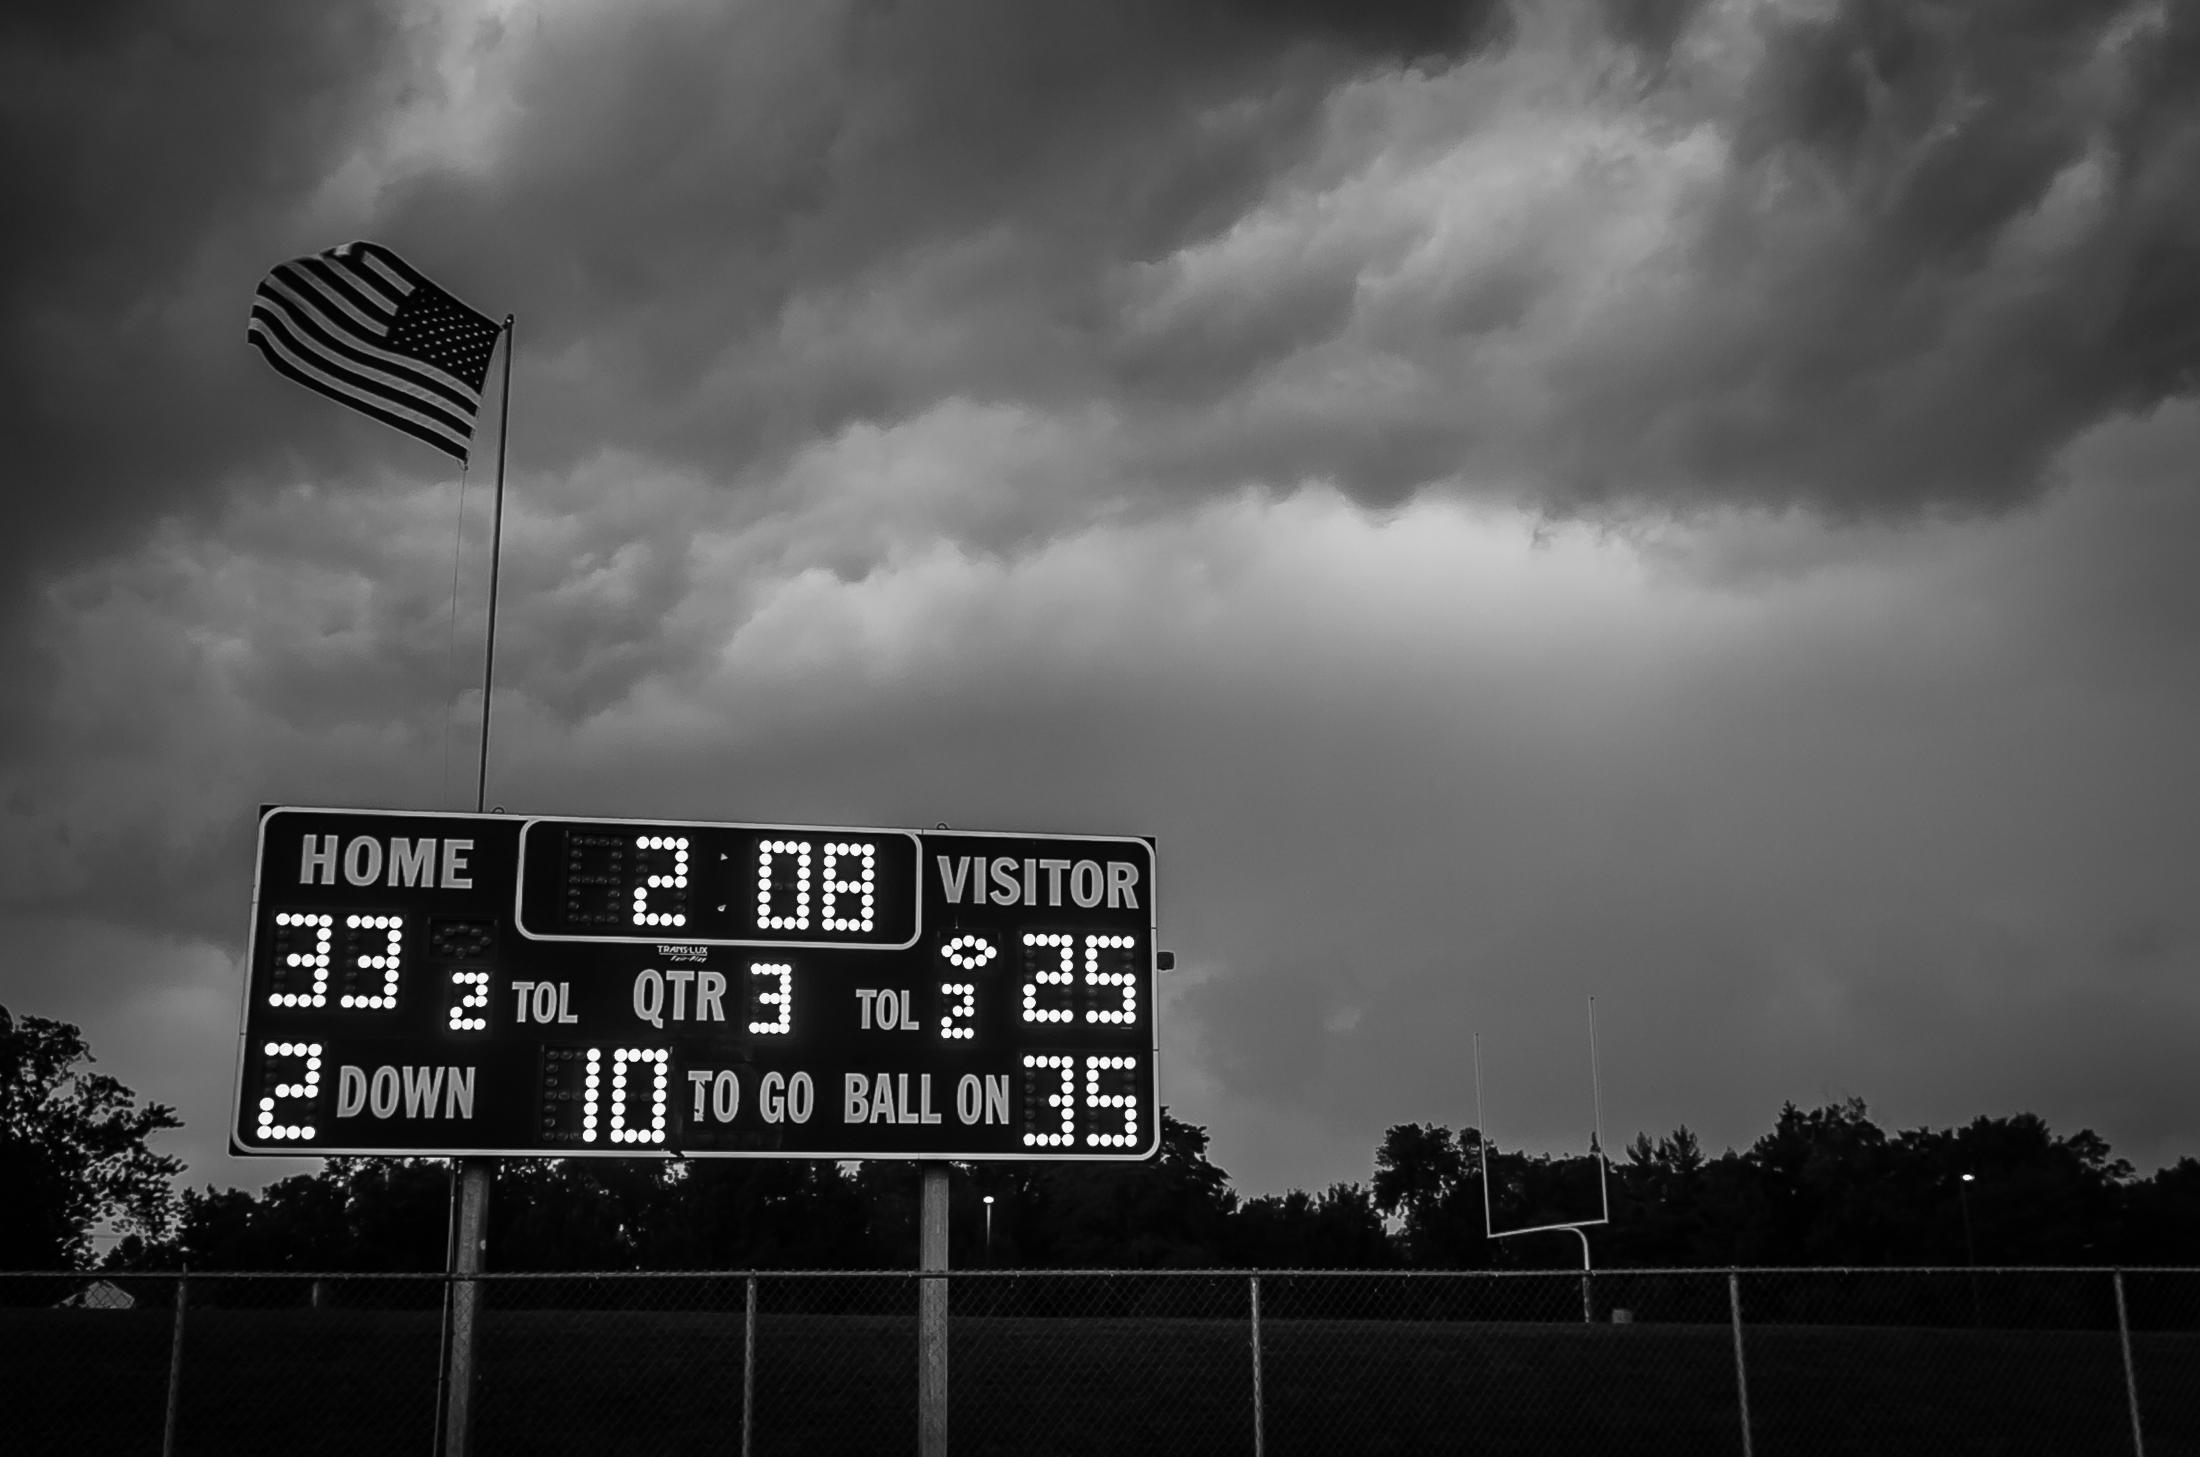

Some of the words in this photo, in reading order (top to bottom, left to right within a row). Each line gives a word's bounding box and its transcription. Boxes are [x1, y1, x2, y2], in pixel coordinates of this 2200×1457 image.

[300, 835, 473, 888] HOME
[937, 856, 1138, 908] VISITOR
[269, 914, 402, 1008] 33
[634, 969, 726, 1028] QTR
[749, 963, 791, 1034] 3
[1023, 934, 1136, 1024] 25
[450, 973, 488, 1030] 2
[512, 982, 577, 1023] TOL
[856, 989, 919, 1030] TOL
[941, 984, 974, 1039] 2
[257, 1043, 322, 1139] 2
[337, 1066, 475, 1118] DOWN
[583, 1049, 668, 1143] 10
[688, 1070, 739, 1122] TO
[760, 1072, 813, 1123] GO
[845, 1073, 941, 1123] BALL
[957, 1074, 1009, 1124] ON
[1024, 1056, 1137, 1147] 35
